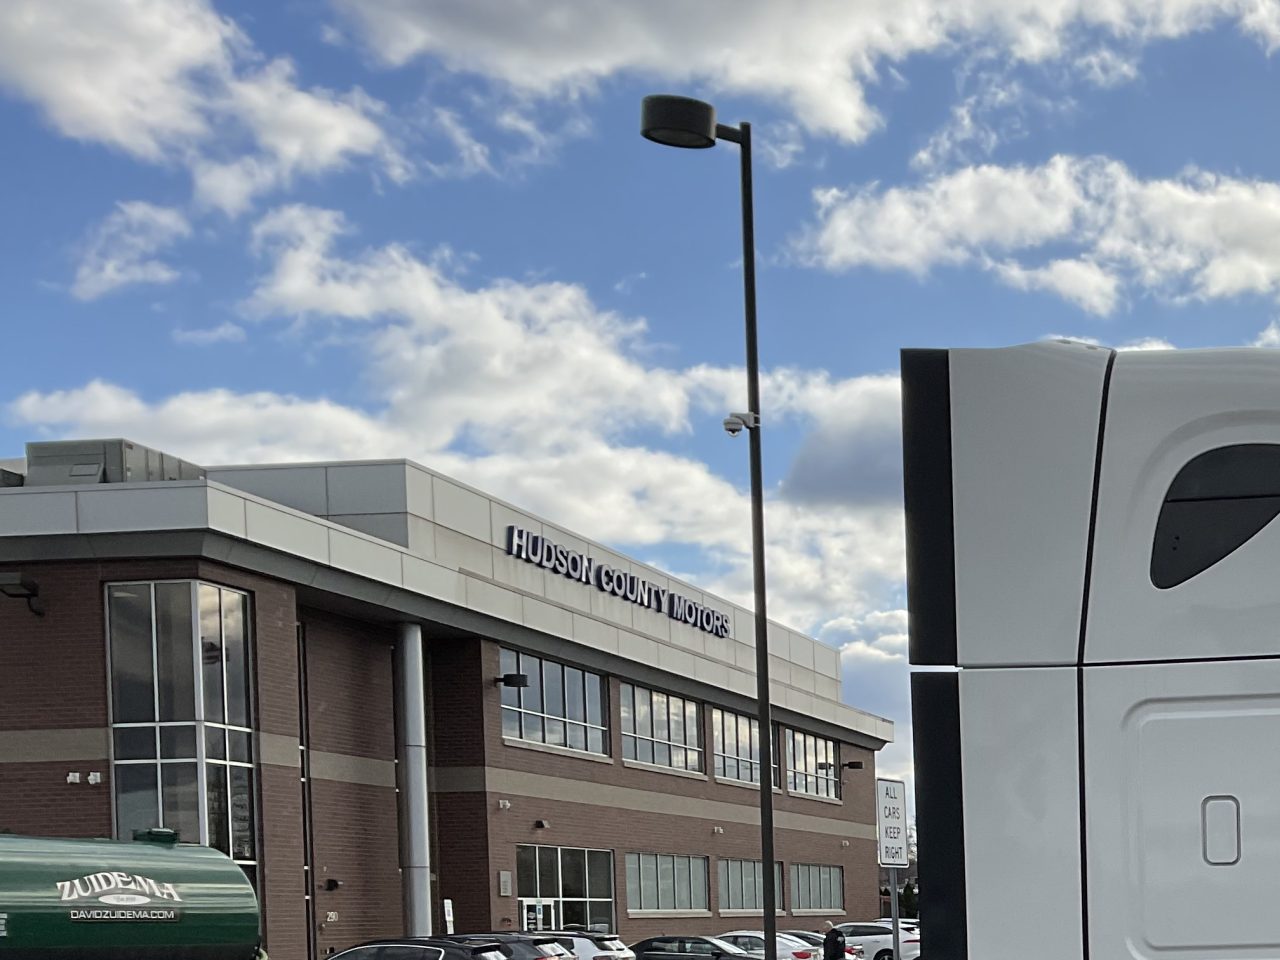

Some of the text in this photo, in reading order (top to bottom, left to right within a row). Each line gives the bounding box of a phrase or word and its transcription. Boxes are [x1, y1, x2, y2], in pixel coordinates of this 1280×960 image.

[507, 525, 731, 638] HUDSON COUNTY MOTORS
[885, 786, 898, 799] ALL
[884, 806, 901, 819] CARS
[885, 826, 901, 839] KEEP
[885, 846, 903, 859] RIGHT
[56, 871, 183, 902] ZUIDEMA
[70, 910, 175, 920] DAVIDZUIDEMA.COM
[326, 911, 338, 922] 290
